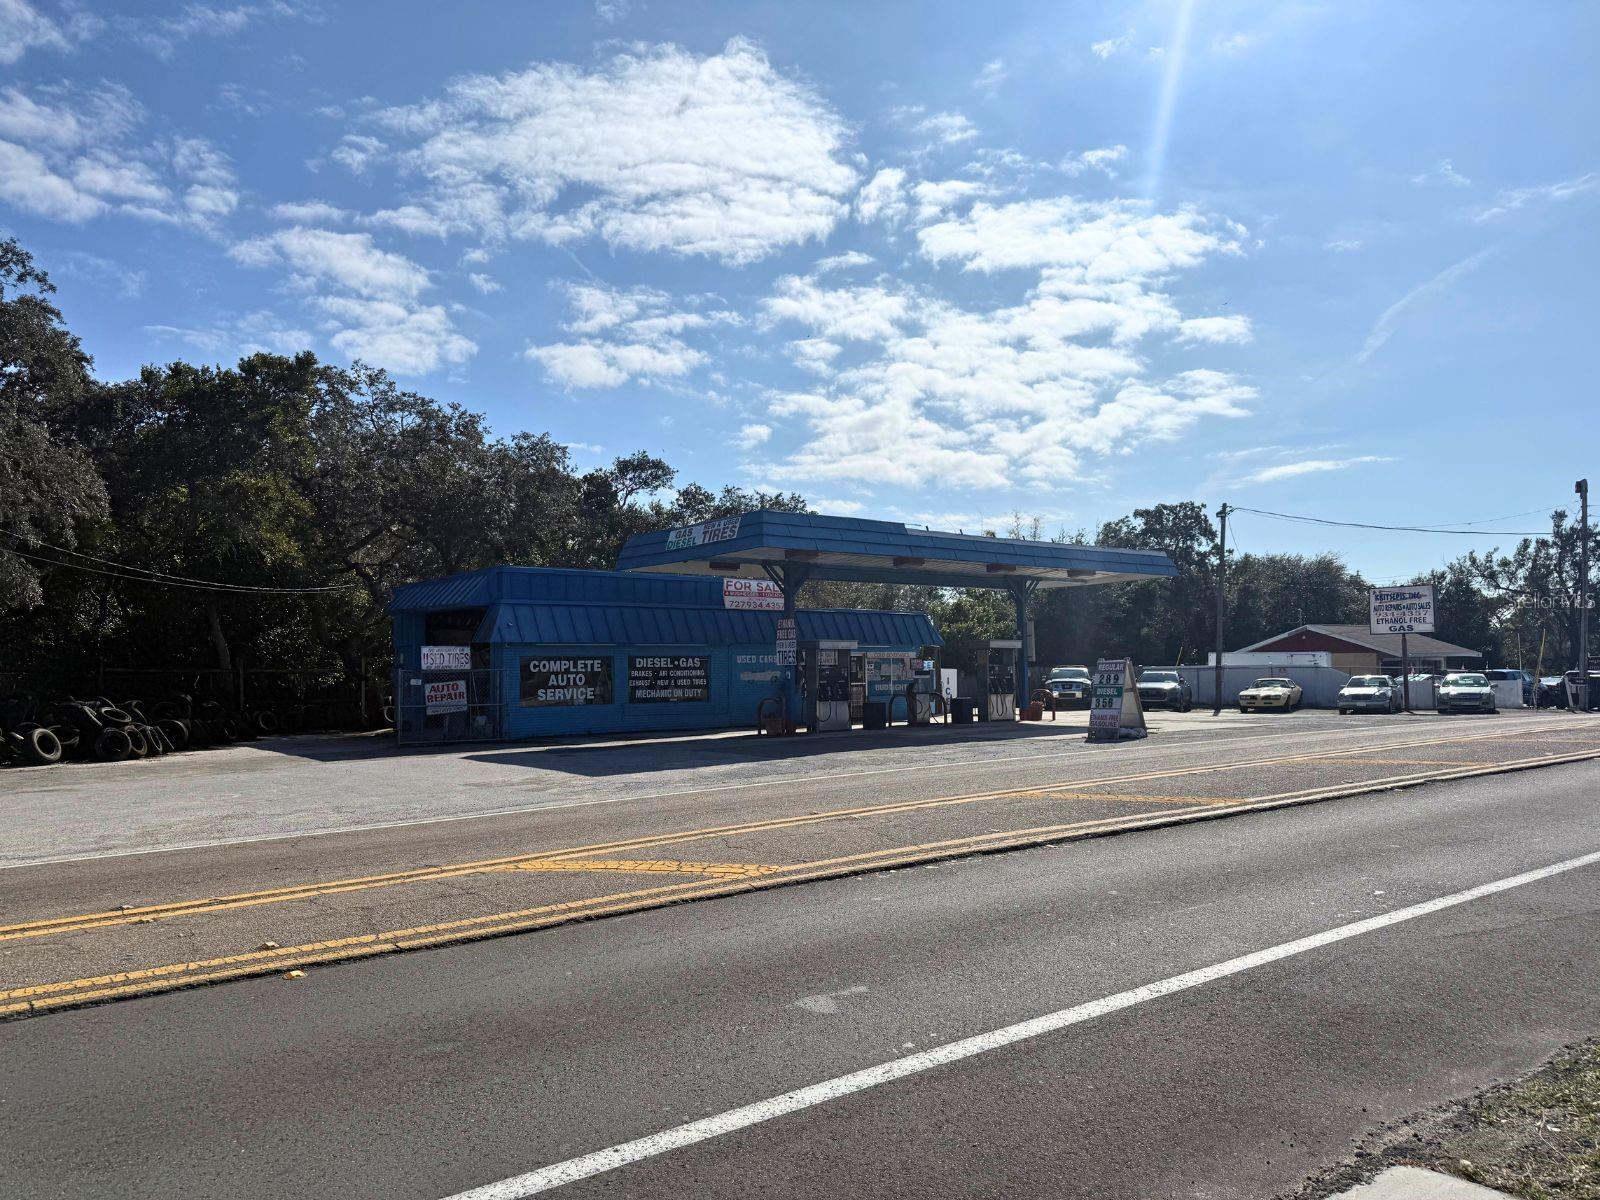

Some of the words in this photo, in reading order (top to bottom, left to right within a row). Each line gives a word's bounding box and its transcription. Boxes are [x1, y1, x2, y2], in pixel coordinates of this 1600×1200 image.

[675, 528, 693, 539] GAS
[702, 525, 737, 543] TIRES
[666, 537, 697, 550] DIESEL
[726, 580, 752, 590] FOR
[757, 582, 780, 592] SAL
[1389, 624, 1414, 632] GAS
[424, 652, 444, 665] USED
[448, 652, 469, 664] TIRES
[636, 658, 674, 668] DIESEL
[680, 657, 700, 668] GAS
[736, 655, 756, 664] USED
[777, 650, 796, 664] TIRES
[530, 660, 602, 672] COMPLETE
[548, 674, 586, 686] AUTO
[692, 678, 707, 686] TIRES
[1100, 674, 1119, 684] 289
[430, 682, 459, 694] AUTO
[636, 688, 672, 698] MECHANIC
[673, 688, 682, 698] ON
[684, 688, 702, 697] DUTY
[426, 692, 465, 704] REPAIR
[537, 688, 595, 701] SERVICE
